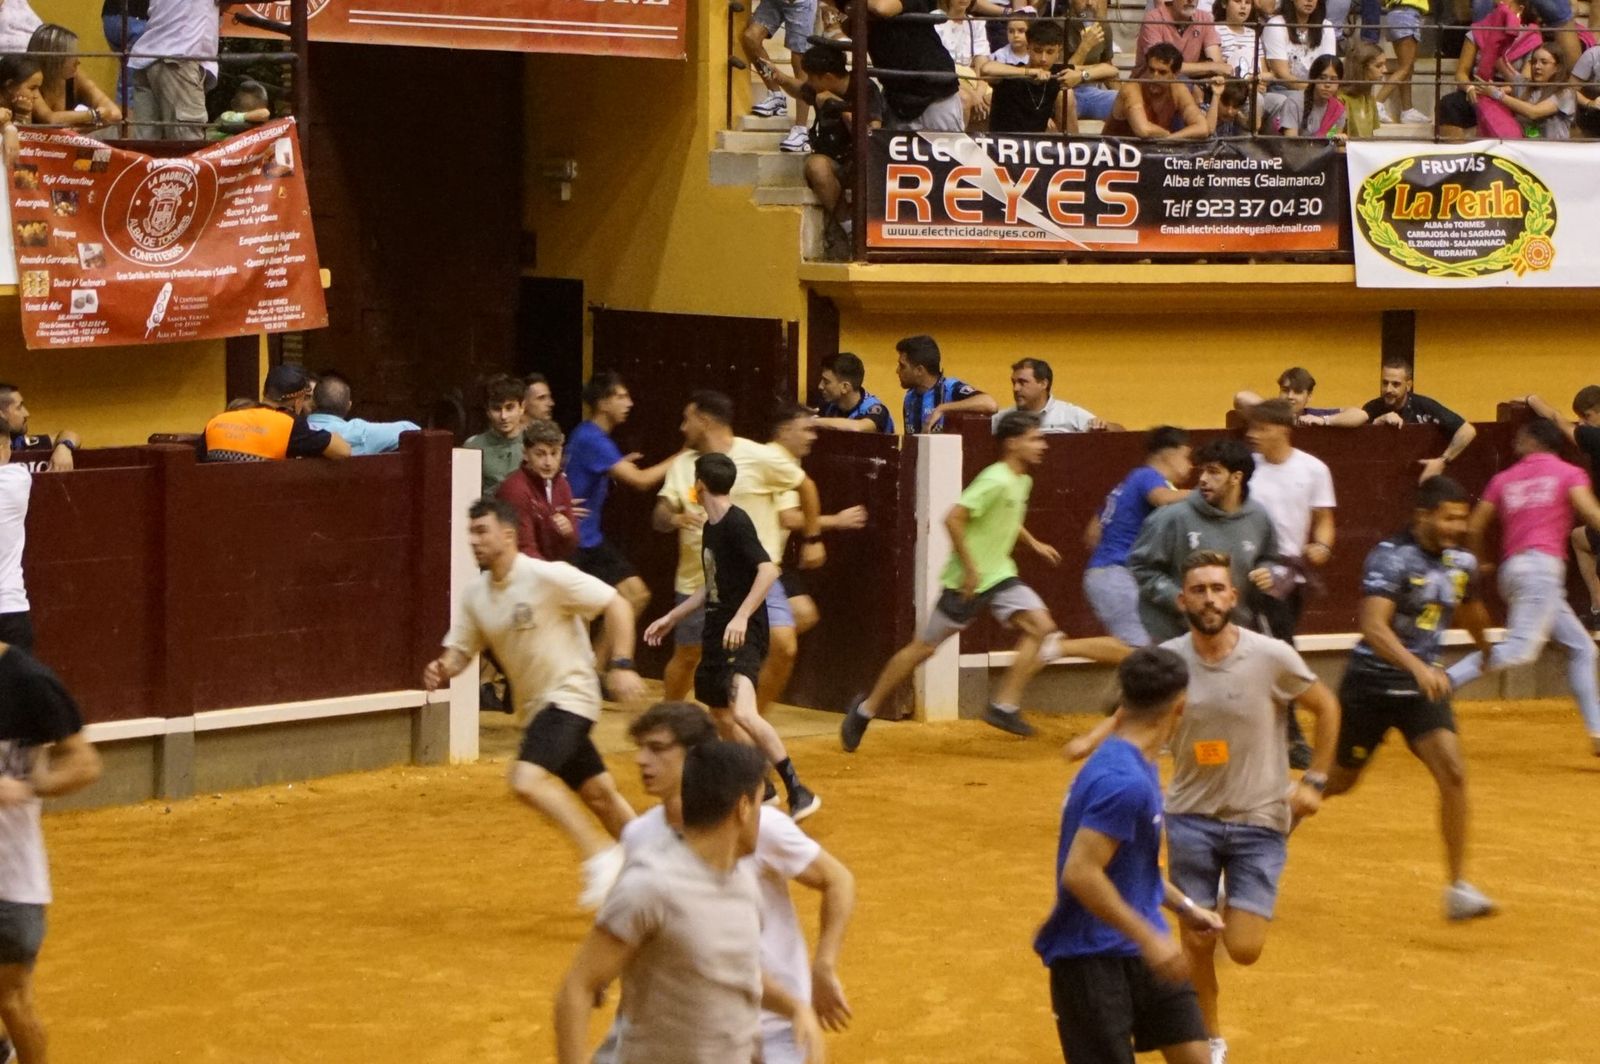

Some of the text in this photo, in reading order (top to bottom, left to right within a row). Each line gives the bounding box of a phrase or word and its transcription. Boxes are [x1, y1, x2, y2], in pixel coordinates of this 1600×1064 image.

[888, 136, 1141, 168] ELECTRICIDAD
[1164, 157, 1192, 170] Ctra:
[1195, 156, 1258, 170] Peñaranda
[1421, 157, 1486, 174] FRUTAS
[1163, 172, 1326, 188] Alba de Tormes (Salamanca)
[886, 164, 1140, 226] REYES
[1392, 180, 1524, 220] La Perla
[1162, 197, 1322, 218] Telf 923 37 04 30
[1454, 220, 1486, 228] TORMES
[887, 226, 1046, 239] www.electricidadreyes.com
[1406, 229, 1506, 238] CARBAJOSA de la SAGRADA
[142, 236, 157, 247] DE
